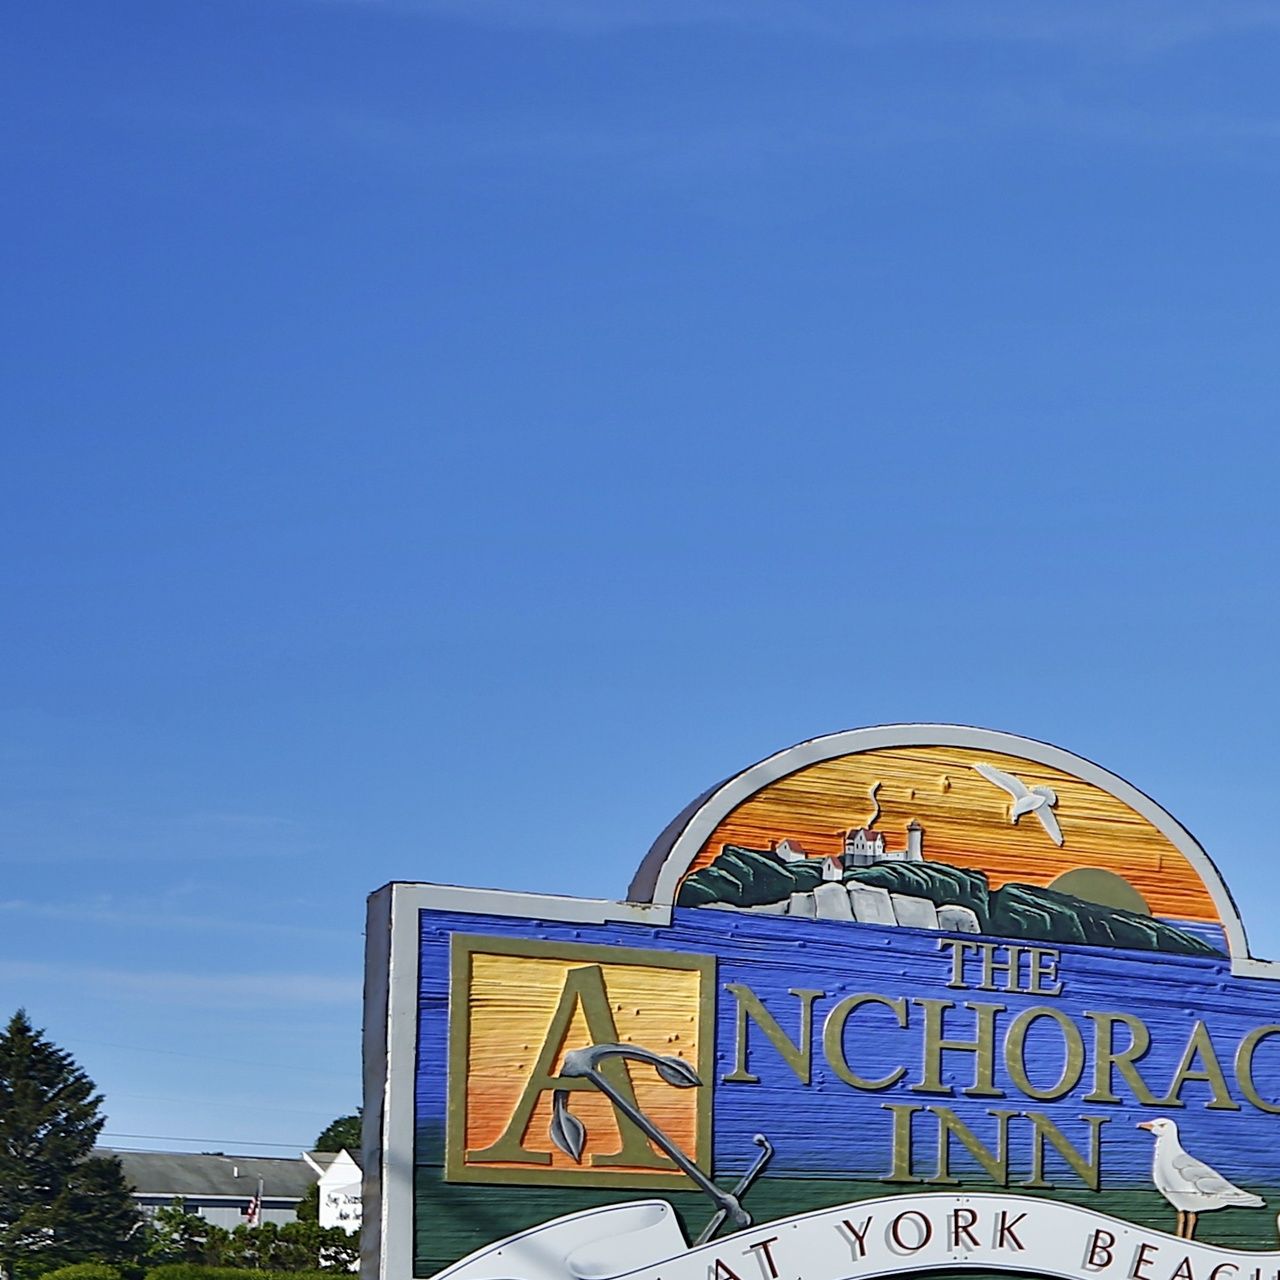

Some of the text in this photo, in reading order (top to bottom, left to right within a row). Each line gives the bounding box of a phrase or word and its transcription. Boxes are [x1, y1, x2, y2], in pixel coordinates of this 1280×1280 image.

[938, 938, 1062, 996] THE
[879, 1103, 1111, 1191] INN
[840, 1209, 1028, 1257] YORK
